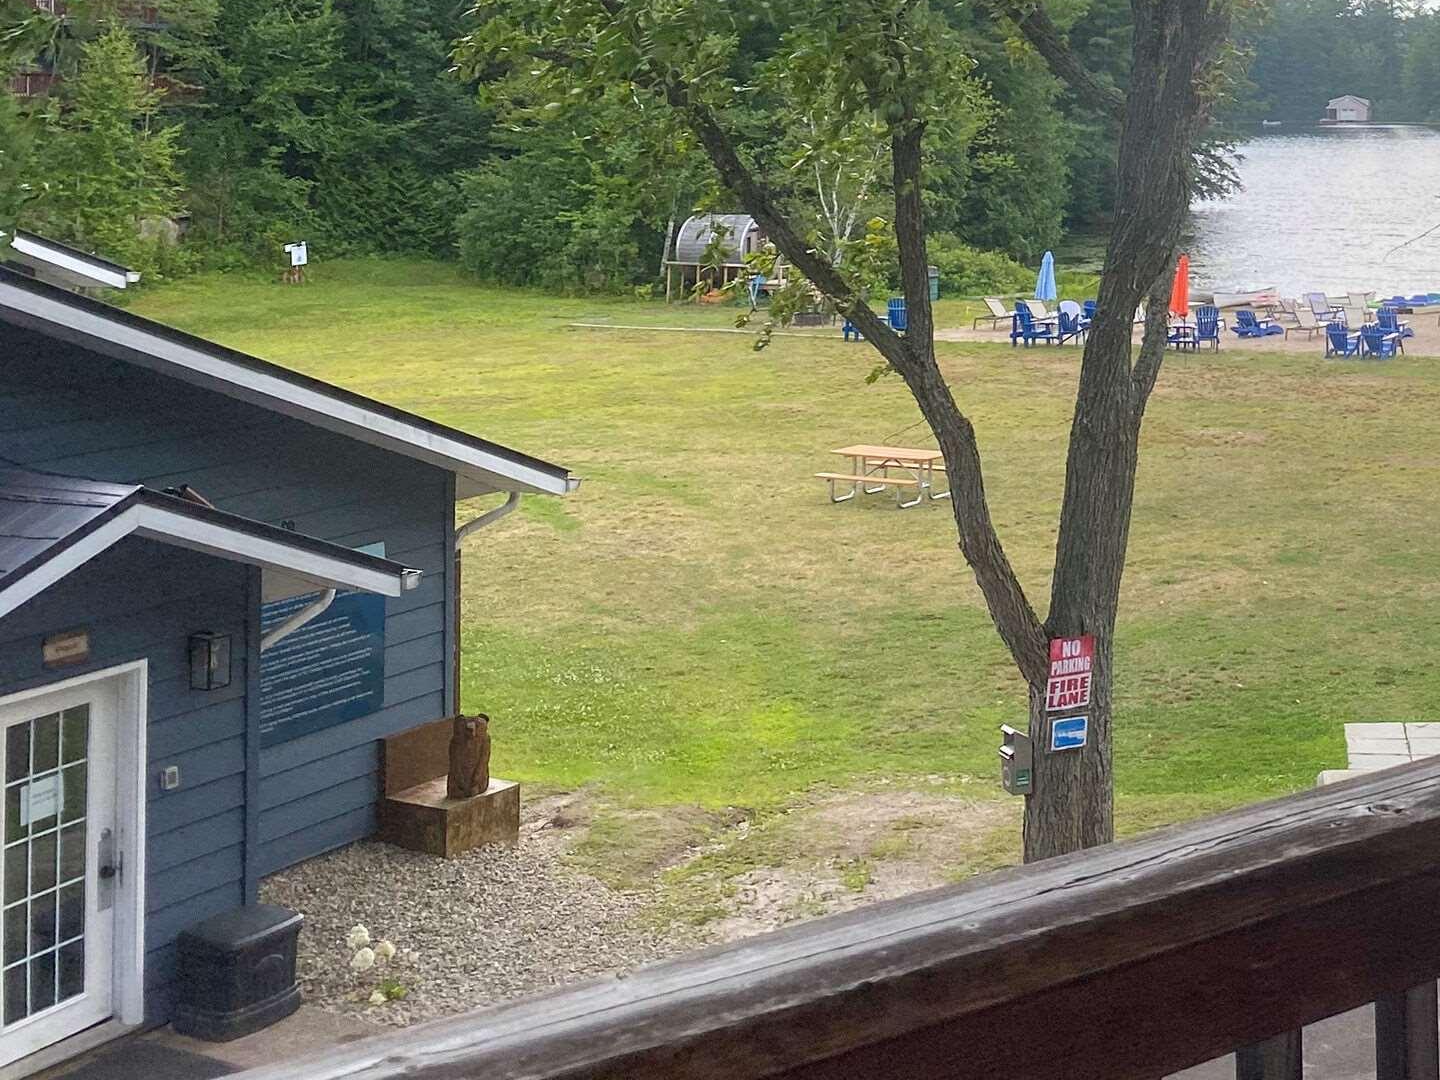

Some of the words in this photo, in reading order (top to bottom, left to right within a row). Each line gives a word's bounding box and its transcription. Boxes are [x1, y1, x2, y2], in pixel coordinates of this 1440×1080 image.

[1062, 640, 1080, 658] NO
[1051, 656, 1090, 675] PARKING
[1050, 676, 1089, 694] FIRE
[1048, 689, 1088, 708] LANE
